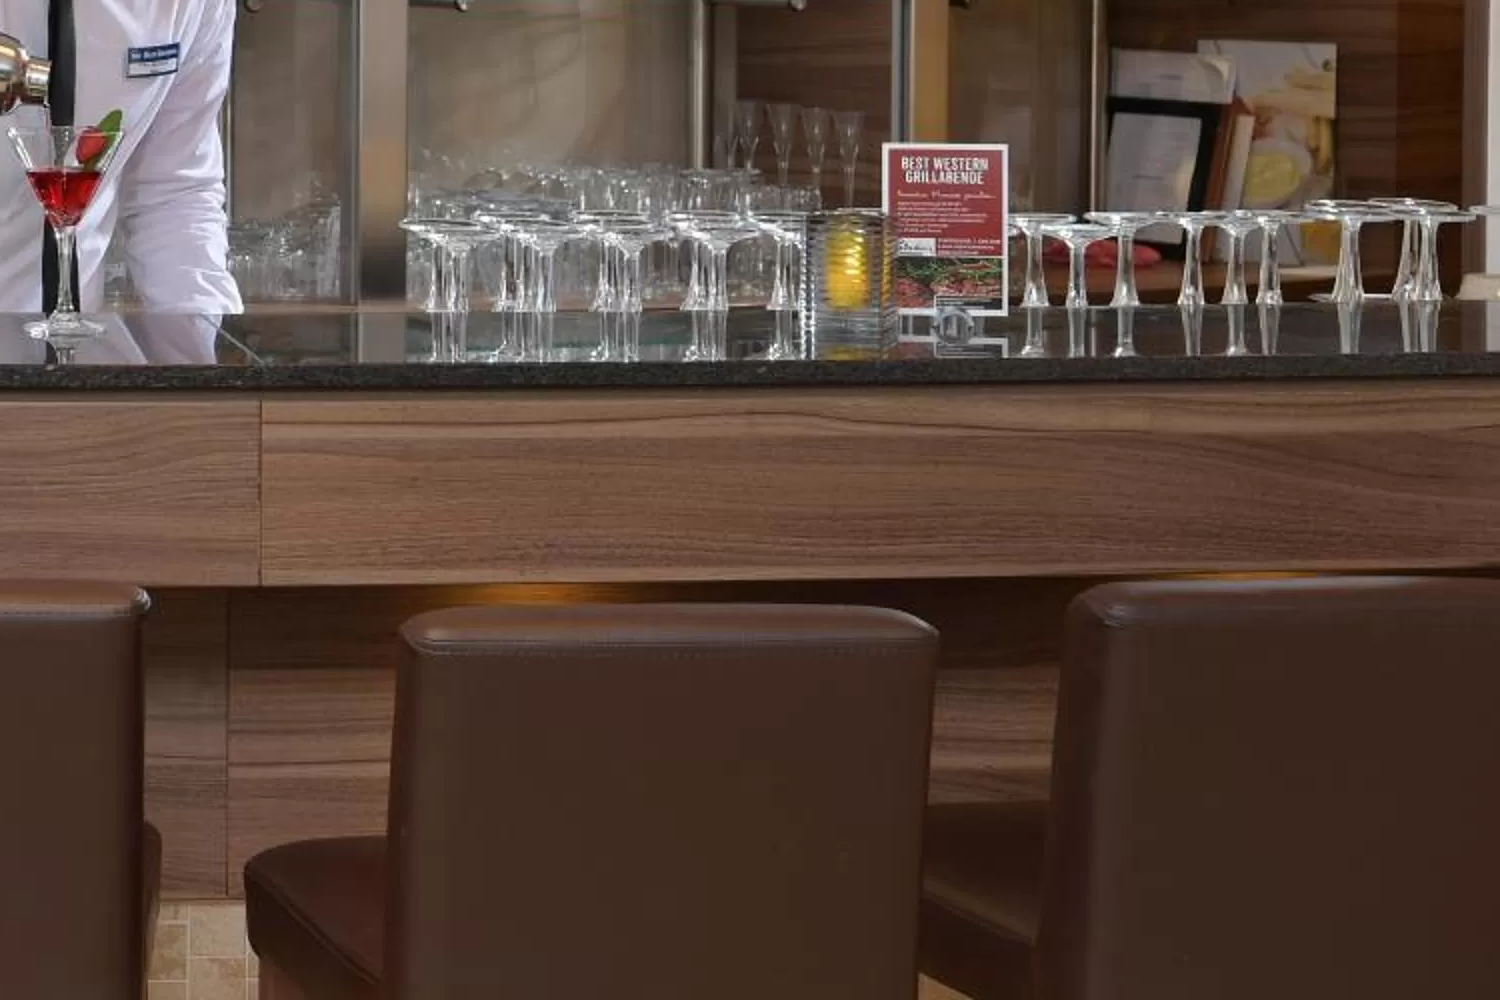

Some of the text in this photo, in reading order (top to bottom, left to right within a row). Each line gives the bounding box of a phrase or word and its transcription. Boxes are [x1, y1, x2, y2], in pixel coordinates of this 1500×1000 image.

[901, 157, 989, 172] BEST WESTERN
[905, 170, 985, 185] GRILLABENDE
